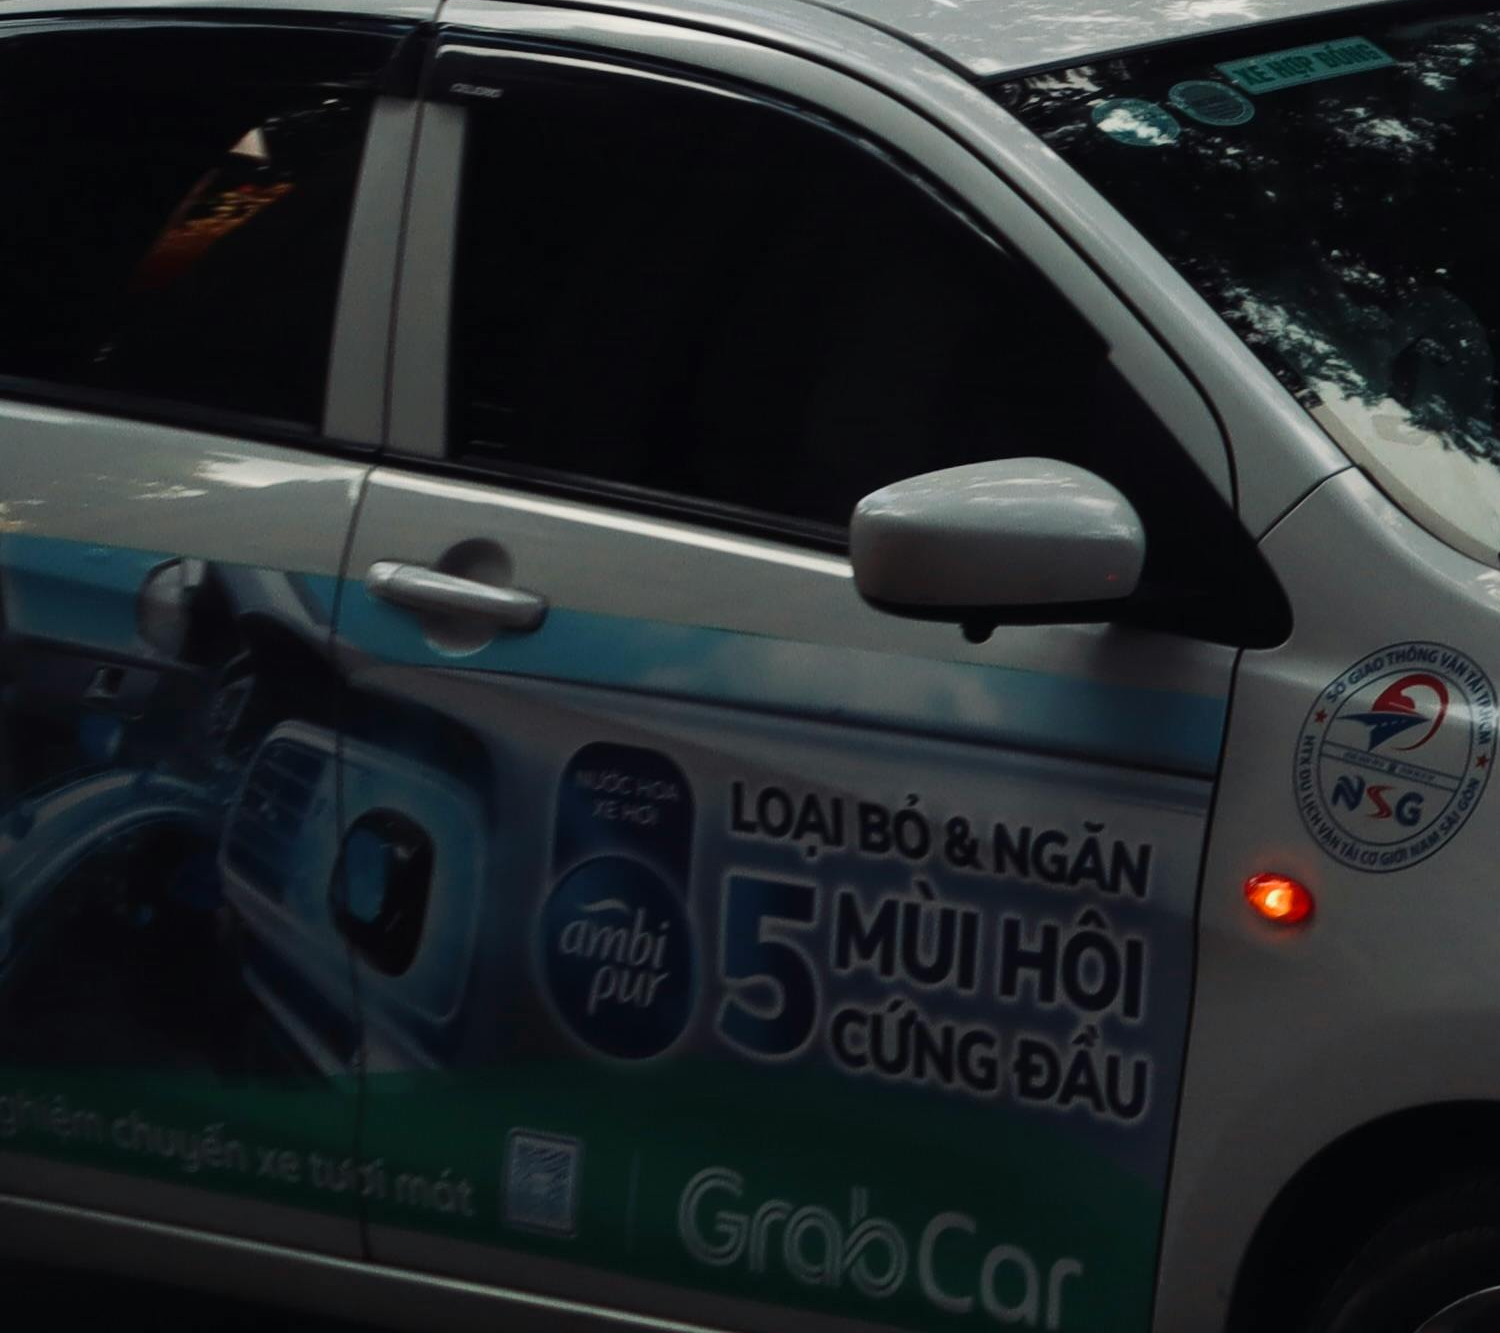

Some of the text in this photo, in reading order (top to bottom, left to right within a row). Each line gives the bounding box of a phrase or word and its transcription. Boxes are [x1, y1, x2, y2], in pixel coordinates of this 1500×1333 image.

[1231, 42, 1386, 87] XE HỢP ĐỒNG
[1325, 683, 1347, 704] SỞ
[1348, 658, 1385, 685] GIAO
[1388, 645, 1439, 666] THÔNG
[1299, 769, 1313, 791] DU
[1330, 774, 1425, 827] NSG
[1301, 793, 1324, 827] LỊCH
[730, 780, 1152, 898] LOẠI BỎ & NGĂN
[1339, 842, 1359, 864] TẢI
[1360, 848, 1379, 867] CƠ
[1410, 830, 1443, 858] NAM
[558, 905, 672, 970] ambi
[717, 871, 1147, 1057] 5 MÙI HÔI
[587, 965, 672, 1015] pur
[829, 998, 1149, 1121] CỨNG ĐẦU
[256, 1146, 302, 1183] xe
[393, 1166, 477, 1218] mát
